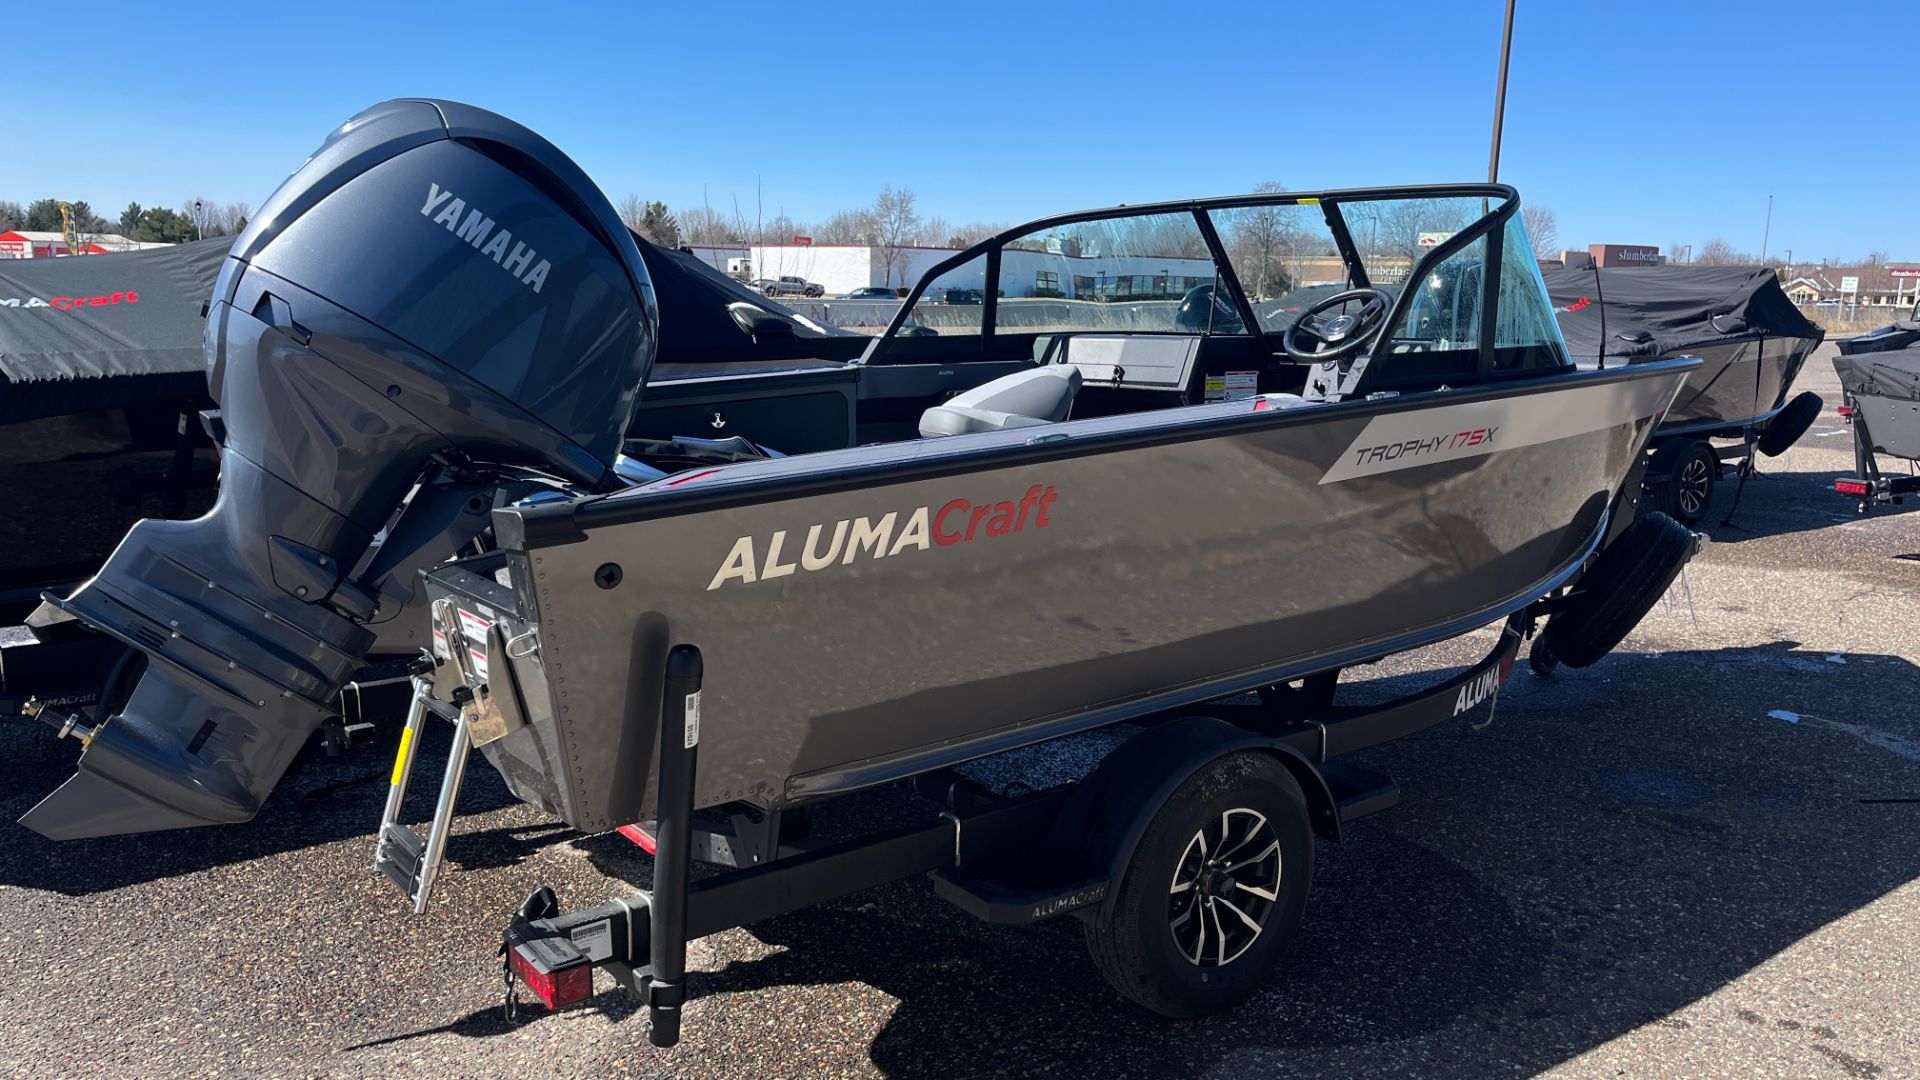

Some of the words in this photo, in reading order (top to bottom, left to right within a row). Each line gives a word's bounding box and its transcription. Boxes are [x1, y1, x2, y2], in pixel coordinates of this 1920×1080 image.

[420, 182, 552, 294] YAMAHA
[1356, 435, 1449, 466] TROPHY
[1449, 426, 1499, 449] 175X
[706, 484, 1059, 592] ALUMACraft
